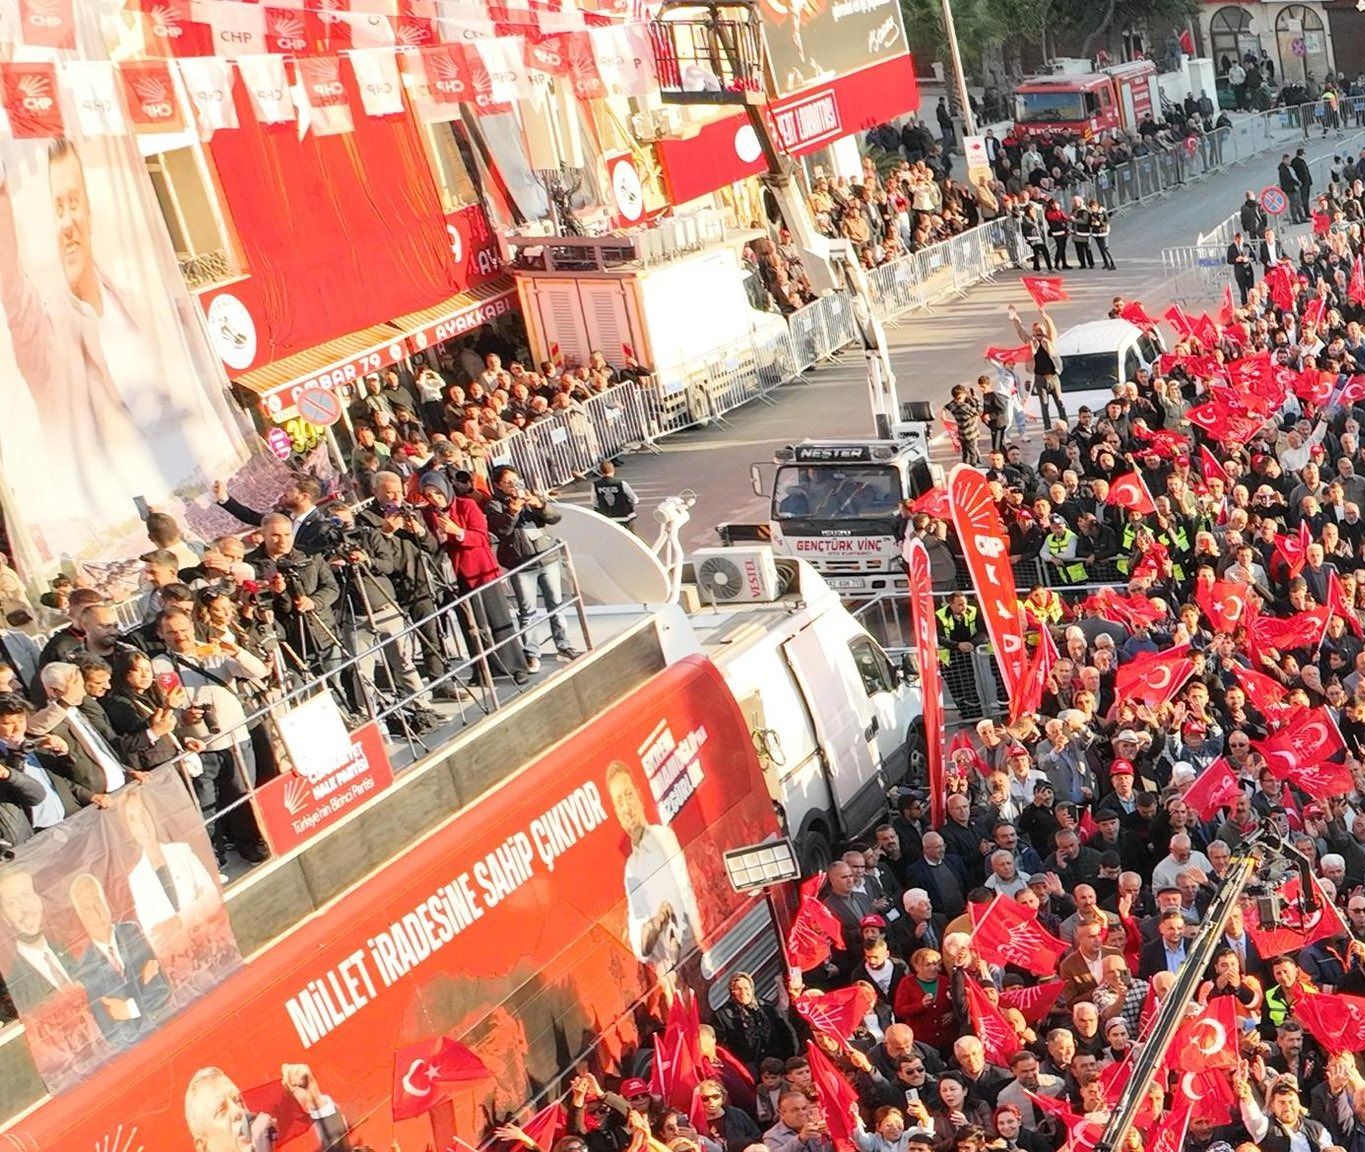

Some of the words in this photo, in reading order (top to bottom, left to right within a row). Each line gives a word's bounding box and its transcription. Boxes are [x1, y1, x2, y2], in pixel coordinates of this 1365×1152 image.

[152, 25, 184, 38] CHP
[221, 30, 253, 44] CHP
[276, 36, 308, 50] CHP
[23, 96, 53, 111] CHP
[435, 298, 511, 341] AYAKKABI
[360, 354, 382, 376] 79
[800, 447, 864, 459] NESTER
[796, 538, 853, 553] GENÇTÜRK
[856, 537, 883, 552] VİNÇ
[745, 559, 761, 598] VESTEL
[284, 948, 378, 1050] MİLLET
[368, 872, 485, 988] İRADESİNE
[473, 834, 537, 909] SAHİP
[529, 780, 609, 873] ÇIKIYOR
